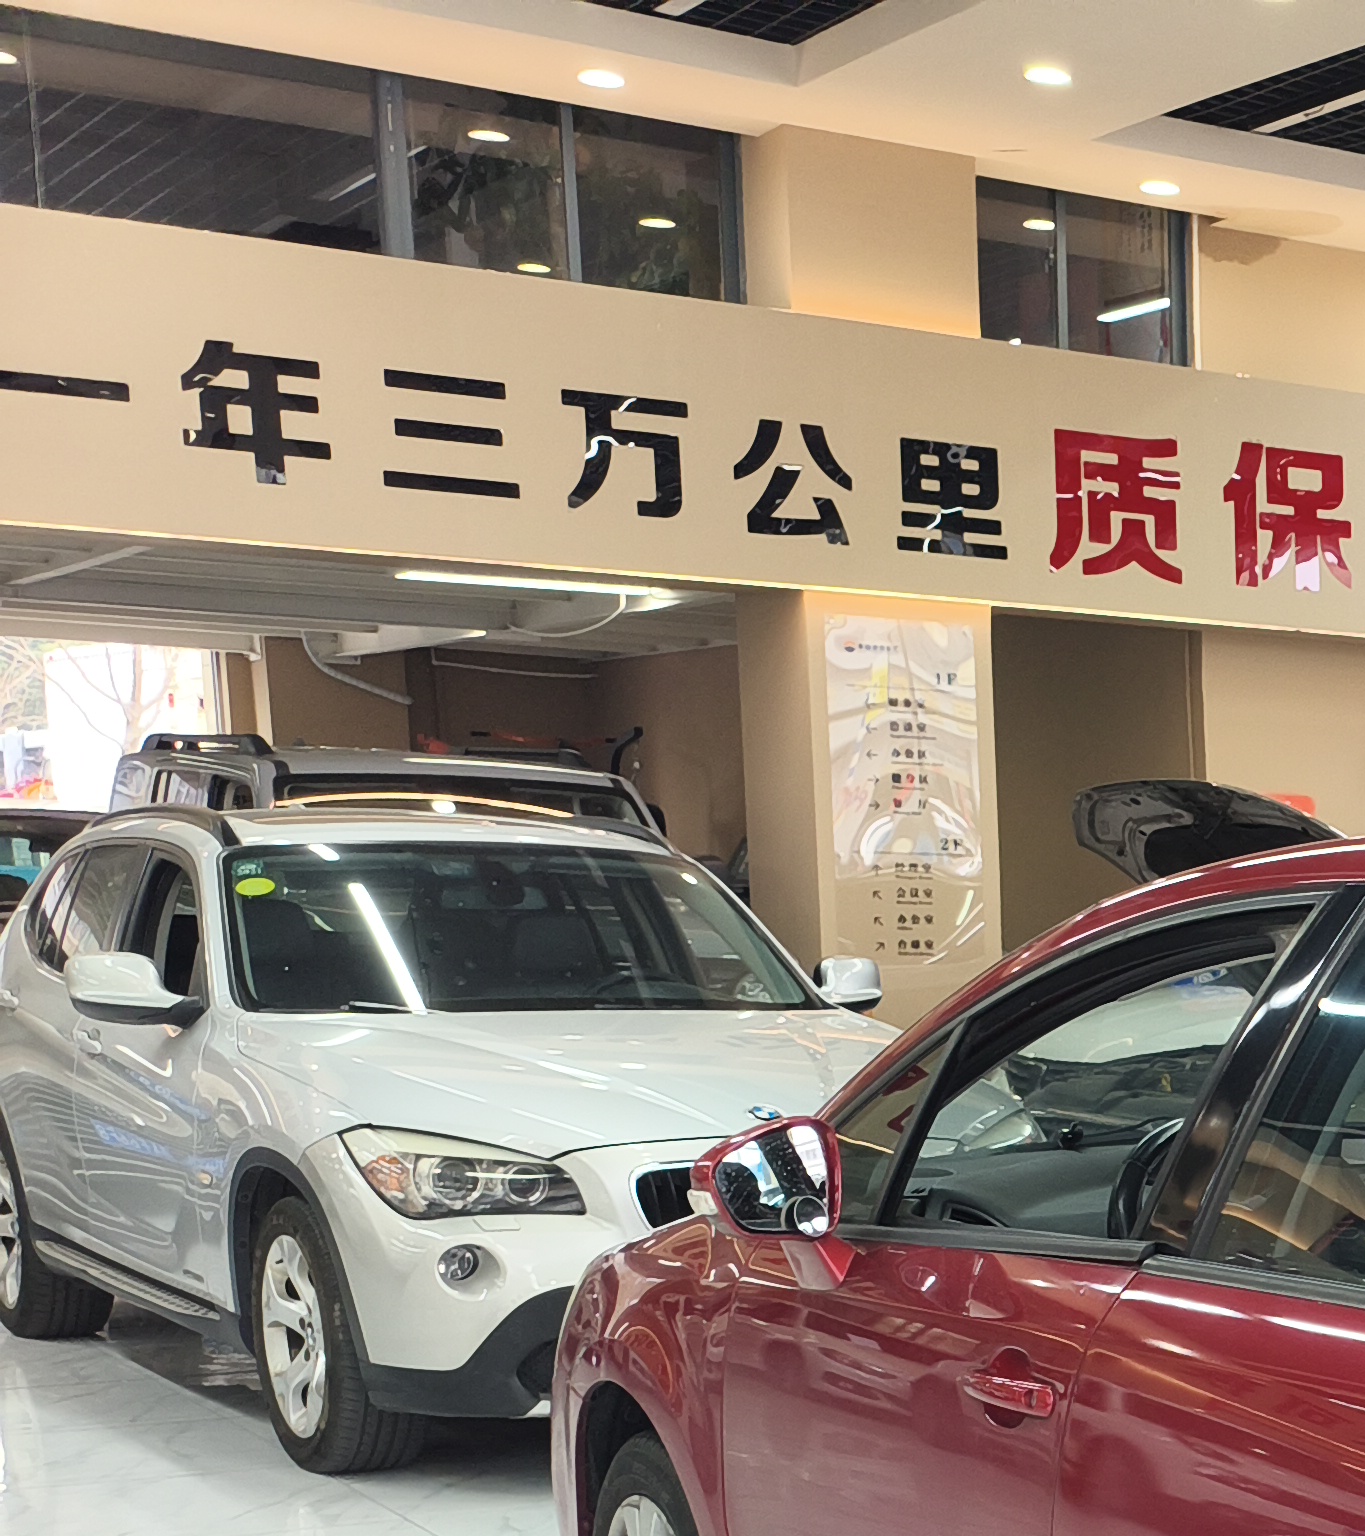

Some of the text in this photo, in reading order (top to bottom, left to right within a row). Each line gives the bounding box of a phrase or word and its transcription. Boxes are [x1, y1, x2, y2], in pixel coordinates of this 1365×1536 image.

[0, 339, 1353, 592] 一年三万公里质保
